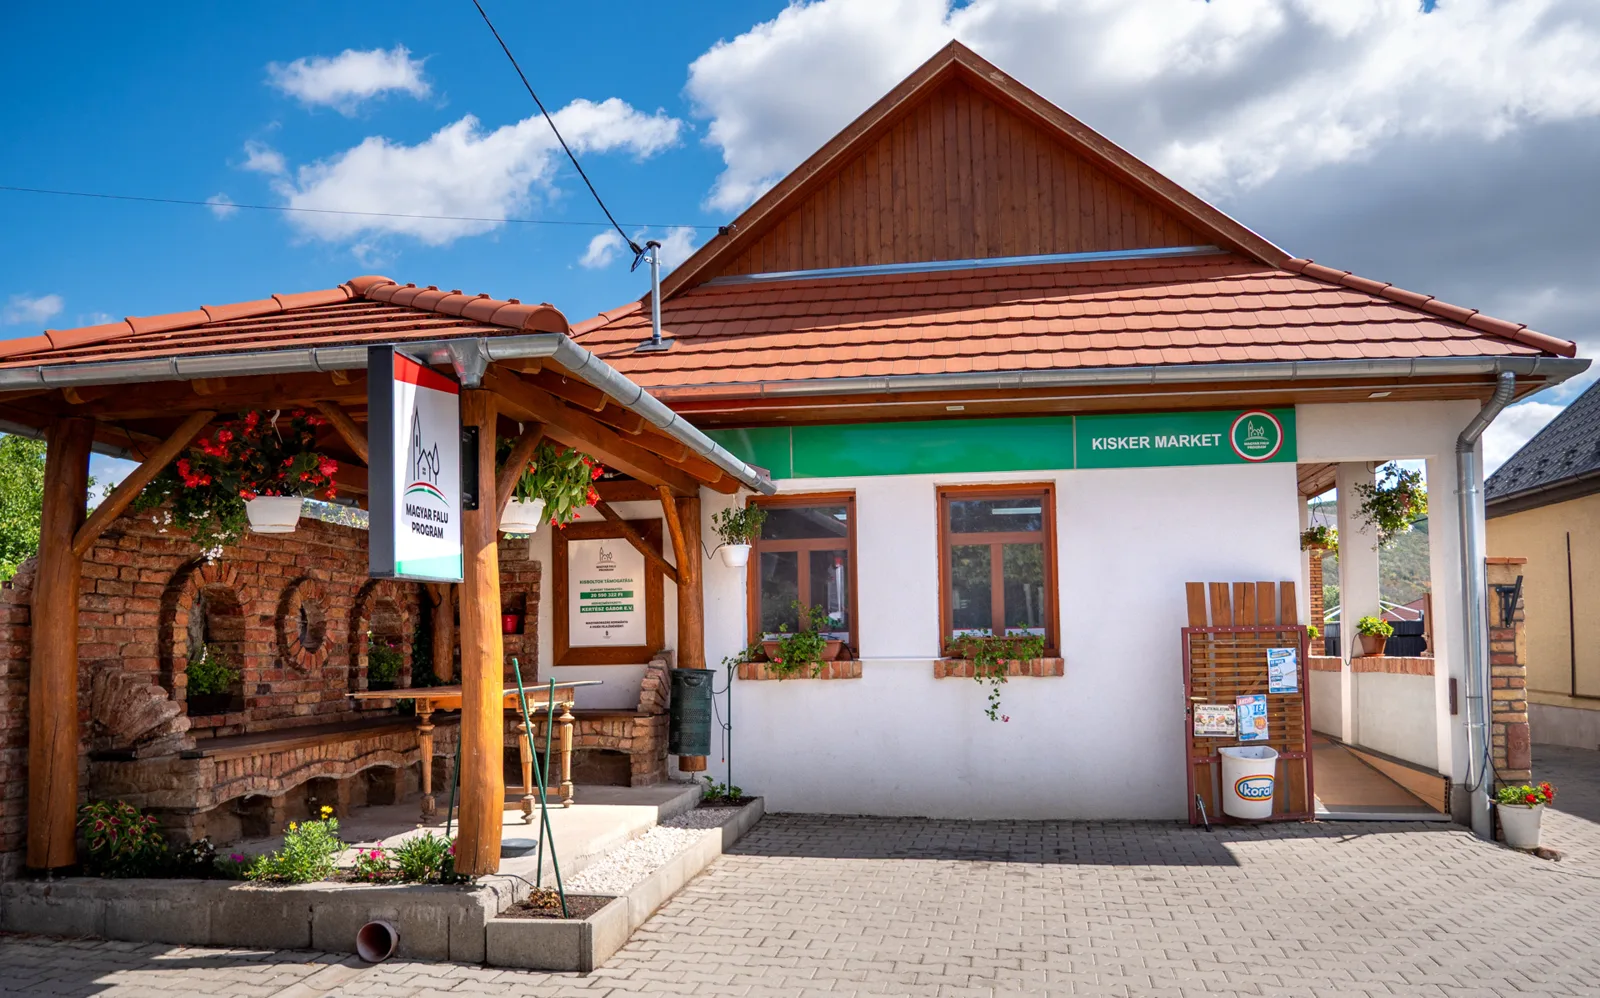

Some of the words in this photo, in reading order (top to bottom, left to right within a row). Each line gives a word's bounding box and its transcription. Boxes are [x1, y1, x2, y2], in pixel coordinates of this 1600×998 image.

[1092, 436, 1151, 450] KISKER
[1155, 433, 1222, 448] MARKET
[405, 503, 433, 521] MAGYAR
[433, 509, 449, 524] FALU
[411, 521, 444, 539] PROGRAM
[1253, 703, 1265, 712] TEJ
